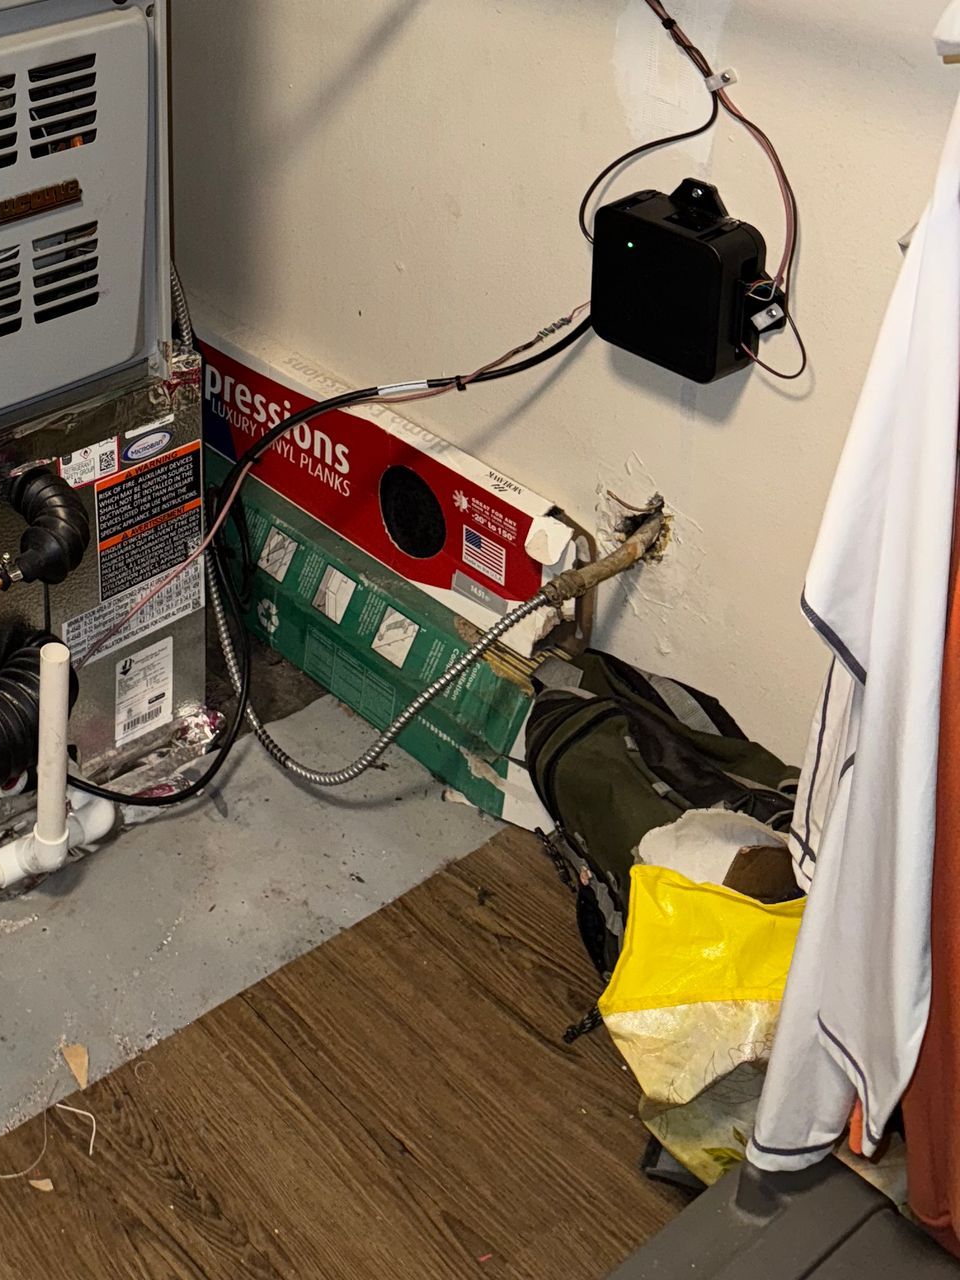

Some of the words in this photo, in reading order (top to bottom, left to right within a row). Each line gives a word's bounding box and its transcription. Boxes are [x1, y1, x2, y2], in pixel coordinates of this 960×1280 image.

[135, 451, 178, 474] WARNING
[212, 397, 257, 437] LUXURY
[261, 427, 295, 464] NYL
[299, 452, 351, 497] PLANKS
[99, 491, 112, 499] RISK
[113, 486, 122, 494] OF
[138, 468, 168, 483] AUXILIARY
[169, 455, 193, 469] DEVICES
[99, 496, 120, 508] WHICH
[121, 490, 133, 499] MAY
[142, 475, 167, 489] IGNITION
[168, 463, 193, 477] SOURCES
[99, 504, 118, 514] SHALL
[120, 497, 132, 507] NOT
[134, 492, 141, 500] BE
[142, 479, 172, 497] INSTALLED
[173, 475, 181, 483] IN
[181, 470, 193, 478] THE
[133, 496, 151, 507] OTHER
[152, 490, 167, 499] THAN
[167, 477, 194, 492] AUXILIARY
[100, 516, 121, 530] DEVICES
[121, 508, 139, 521] LISTED
[140, 503, 150, 512] FOR
[151, 499, 161, 507] USE
[161, 493, 176, 502] WITH
[176, 486, 187, 495] THE
[100, 525, 122, 538] SPECIFIC
[151, 507, 161, 515] SEE
[131, 507, 185, 535] AVERTISSEMENT
[471, 497, 490, 512] GREAT
[491, 508, 504, 518] FOR
[504, 516, 517, 526] ANY
[488, 520, 497, 532] to
